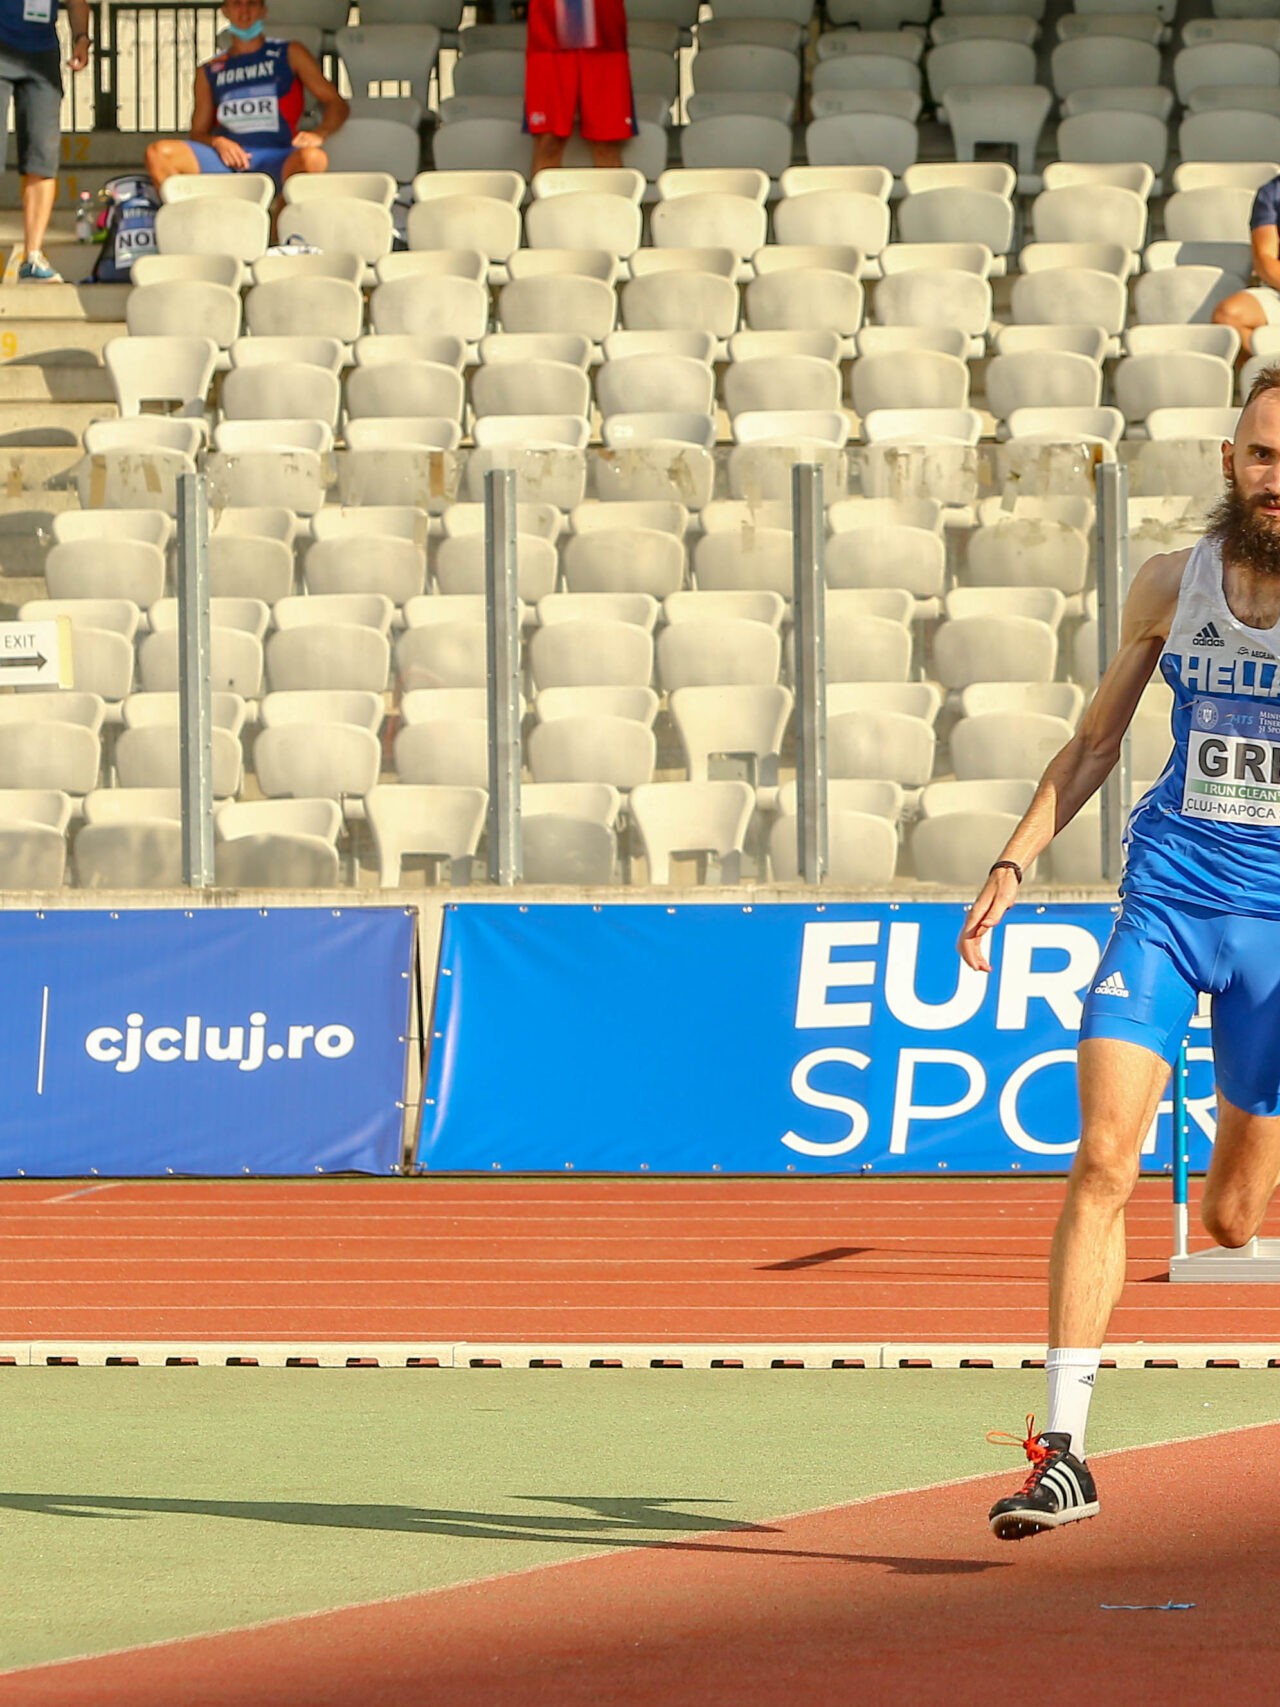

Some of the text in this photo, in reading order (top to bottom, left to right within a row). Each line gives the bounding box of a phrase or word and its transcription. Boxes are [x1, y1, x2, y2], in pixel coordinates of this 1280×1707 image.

[216, 60, 275, 87] NORWAY
[223, 100, 273, 116] NOR
[119, 231, 157, 248] NO
[2, 331, 18, 358] 9
[4, 633, 36, 649] EXIT
[1192, 637, 1225, 647] adidas
[1209, 784, 1236, 797] RUN
[1186, 798, 1276, 819] CLUJ-NAPOCA
[1094, 986, 1130, 998] adidas
[85, 1011, 355, 1073] cjcluj.ro
